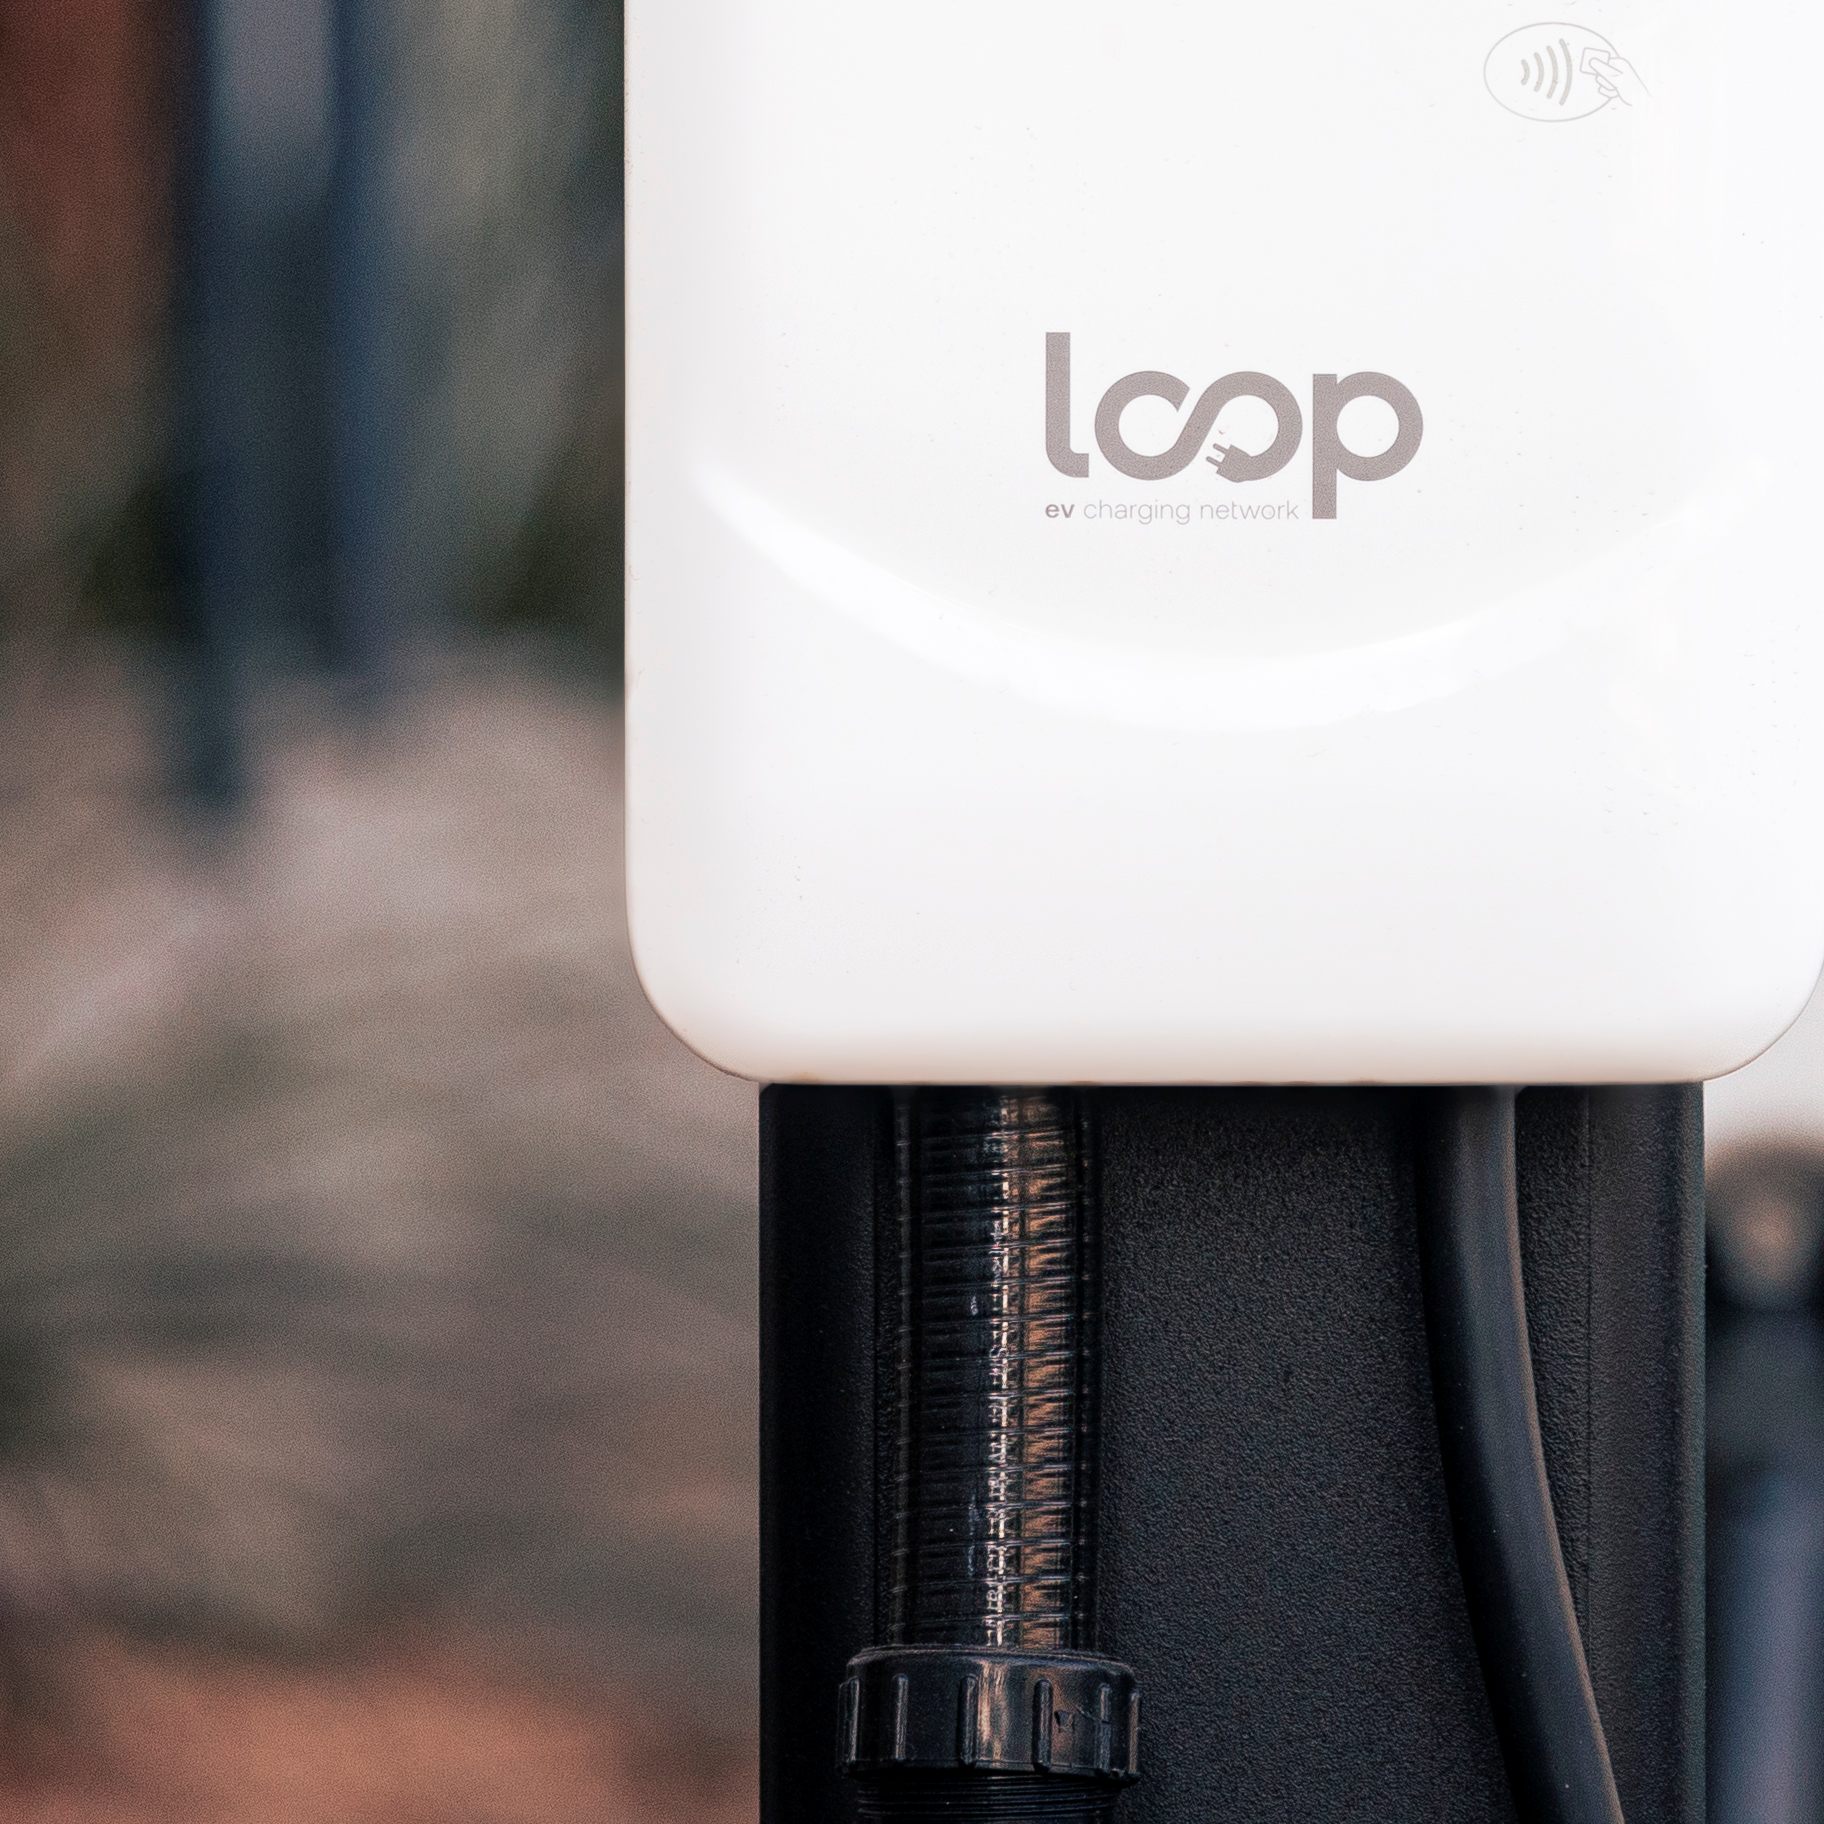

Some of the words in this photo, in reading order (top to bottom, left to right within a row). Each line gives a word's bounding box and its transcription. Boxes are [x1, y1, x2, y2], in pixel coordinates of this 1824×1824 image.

[1044, 331, 1425, 521] loop
[1044, 502, 1077, 519] ev
[1083, 499, 1191, 526] charging
[1199, 499, 1301, 521] network
